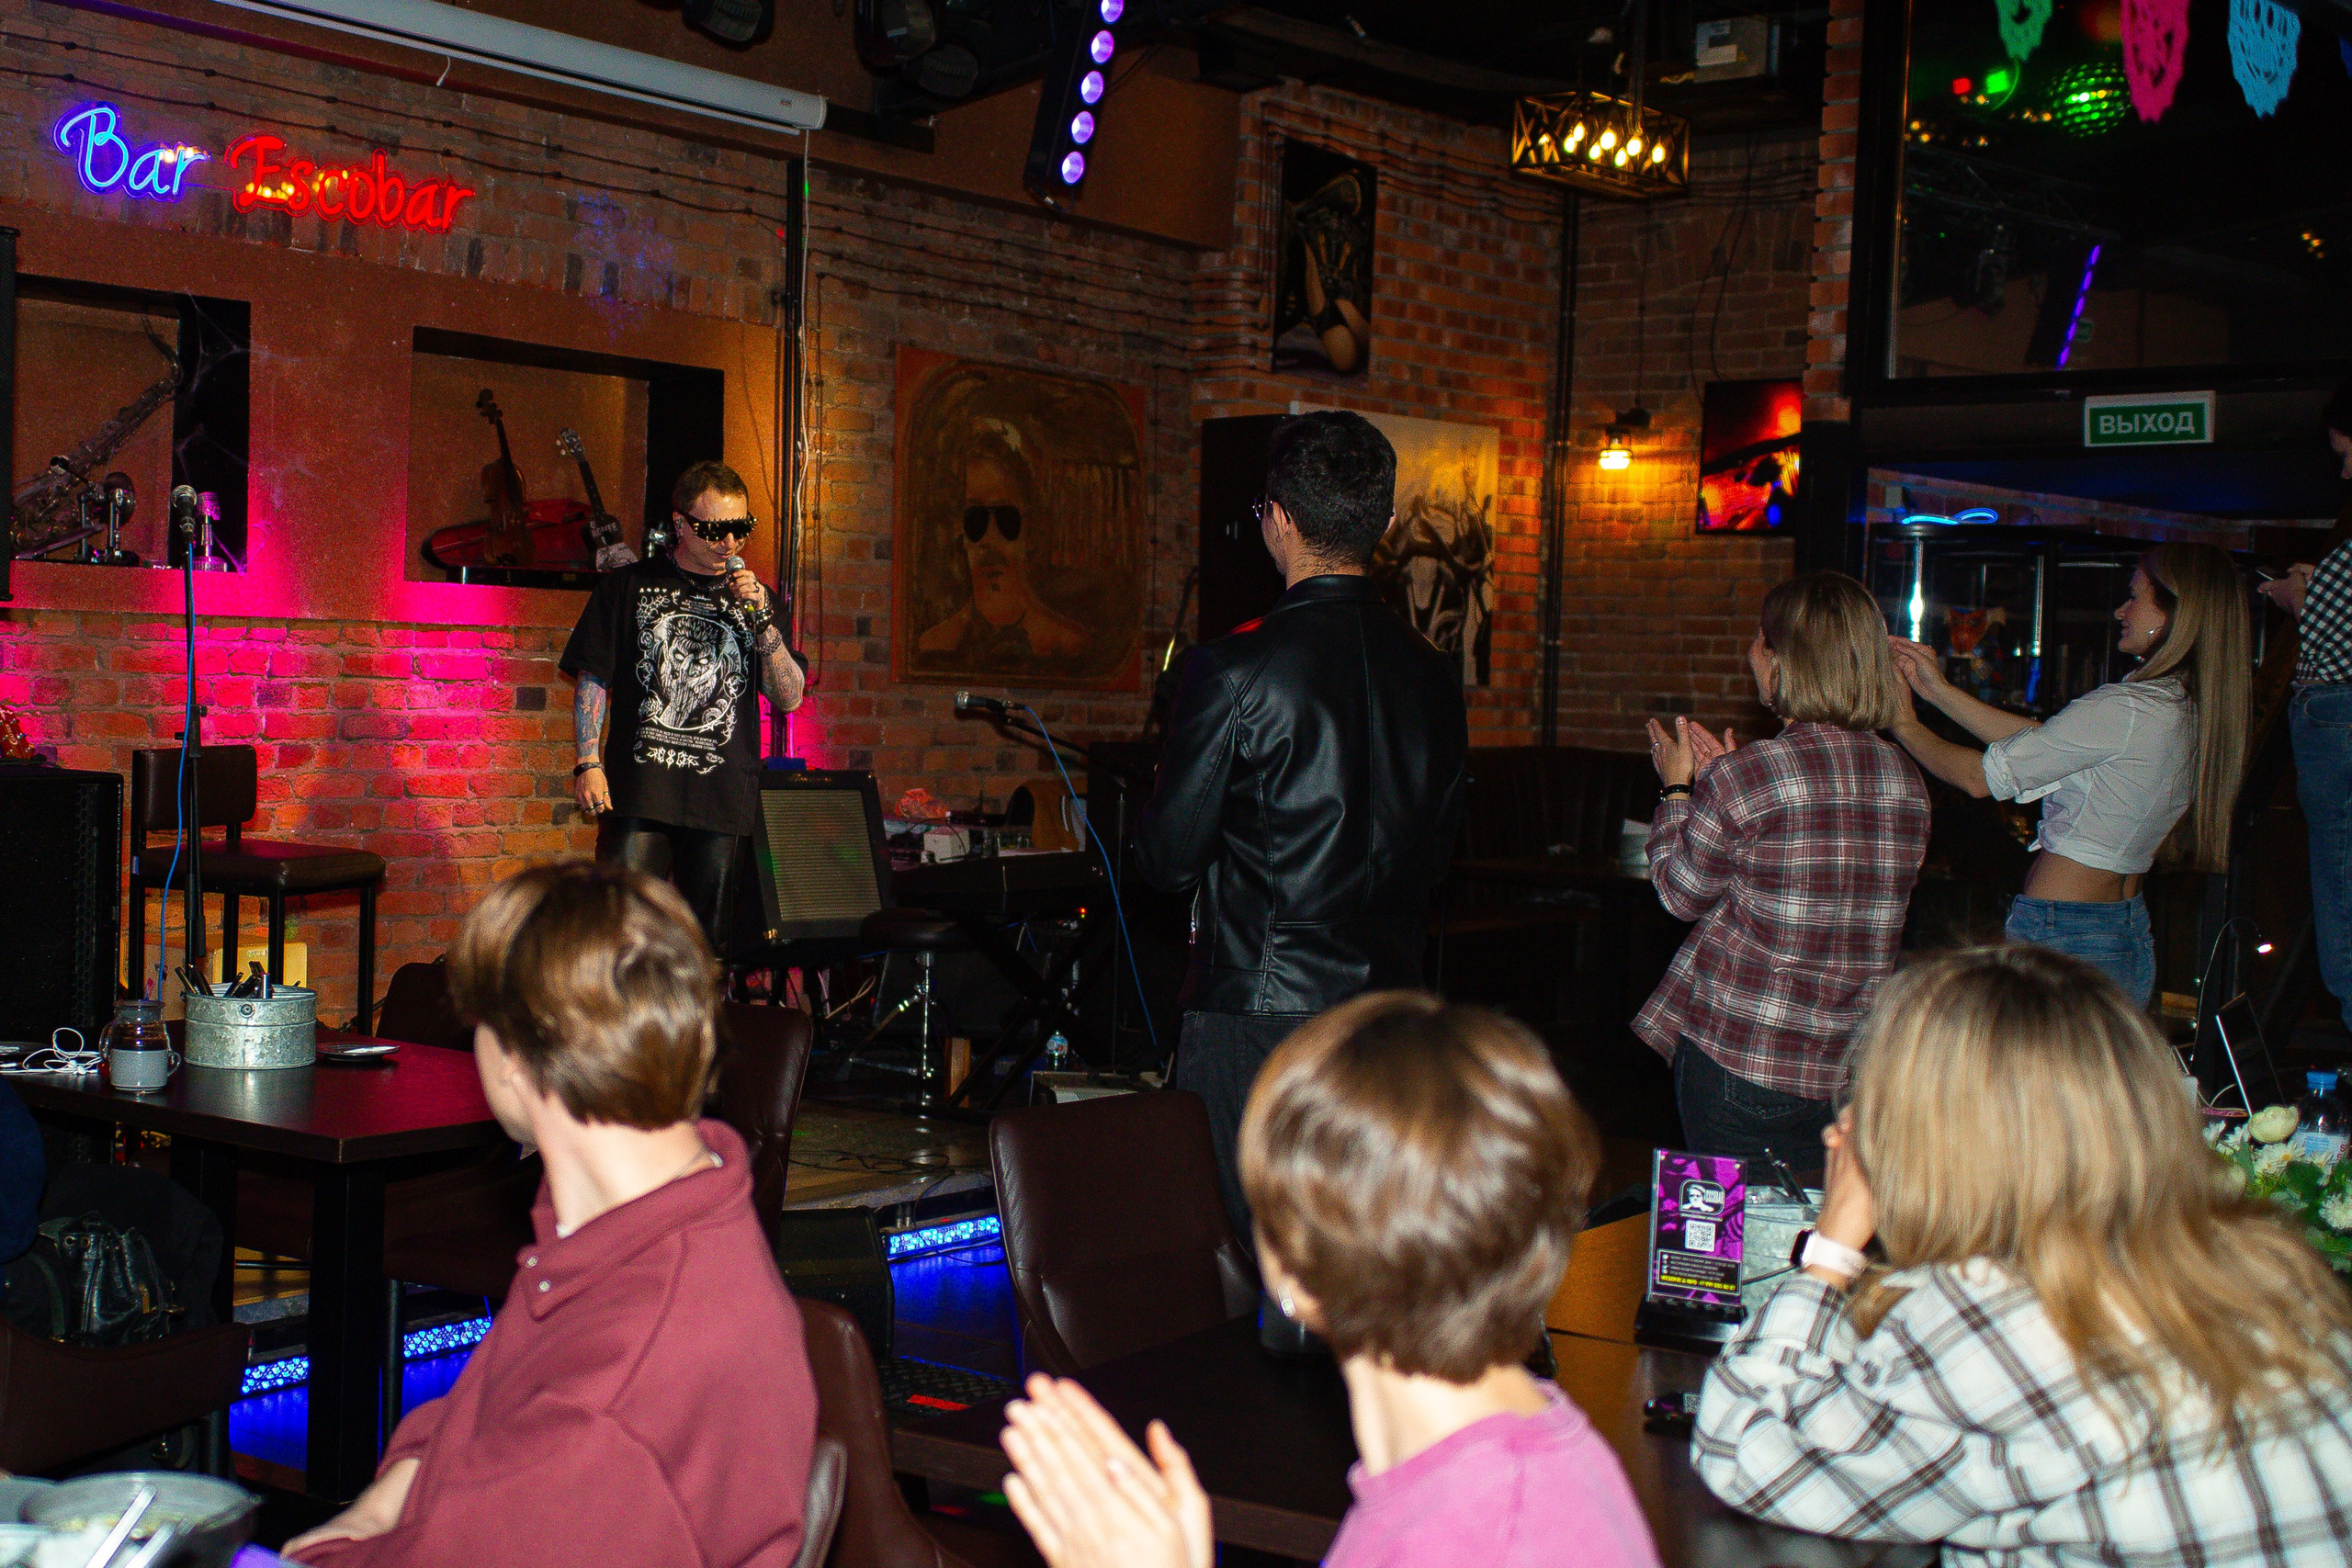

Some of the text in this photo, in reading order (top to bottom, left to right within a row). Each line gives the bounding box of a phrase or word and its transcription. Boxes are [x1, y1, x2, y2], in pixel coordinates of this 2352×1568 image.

[58, 105, 473, 230] Bar Escobar
[2099, 411, 2195, 434] ВЫХОД
